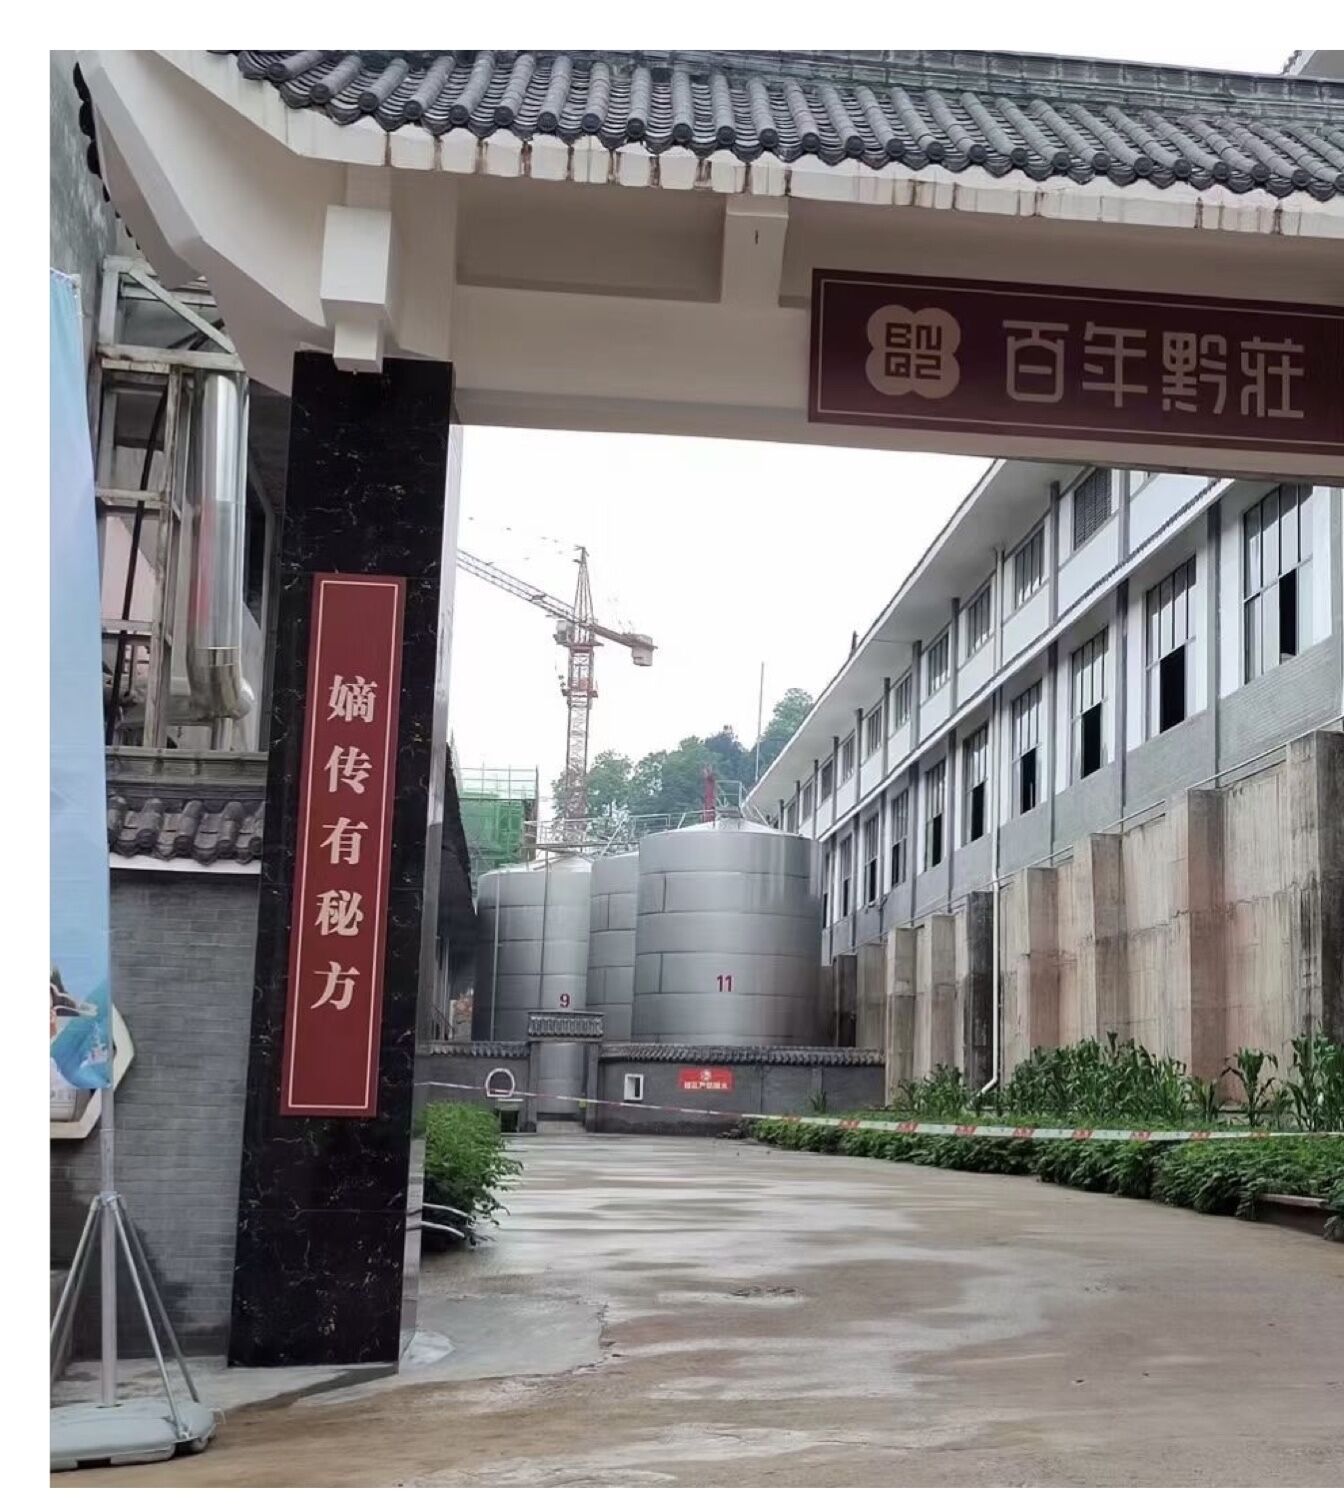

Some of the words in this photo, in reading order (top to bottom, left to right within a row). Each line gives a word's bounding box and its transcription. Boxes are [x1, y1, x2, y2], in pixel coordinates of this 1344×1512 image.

[1002, 319, 1305, 420] 百年黔莊
[310, 674, 378, 1011] 嫡传有秘方
[559, 993, 571, 1009] 9
[717, 974, 732, 993] 11
